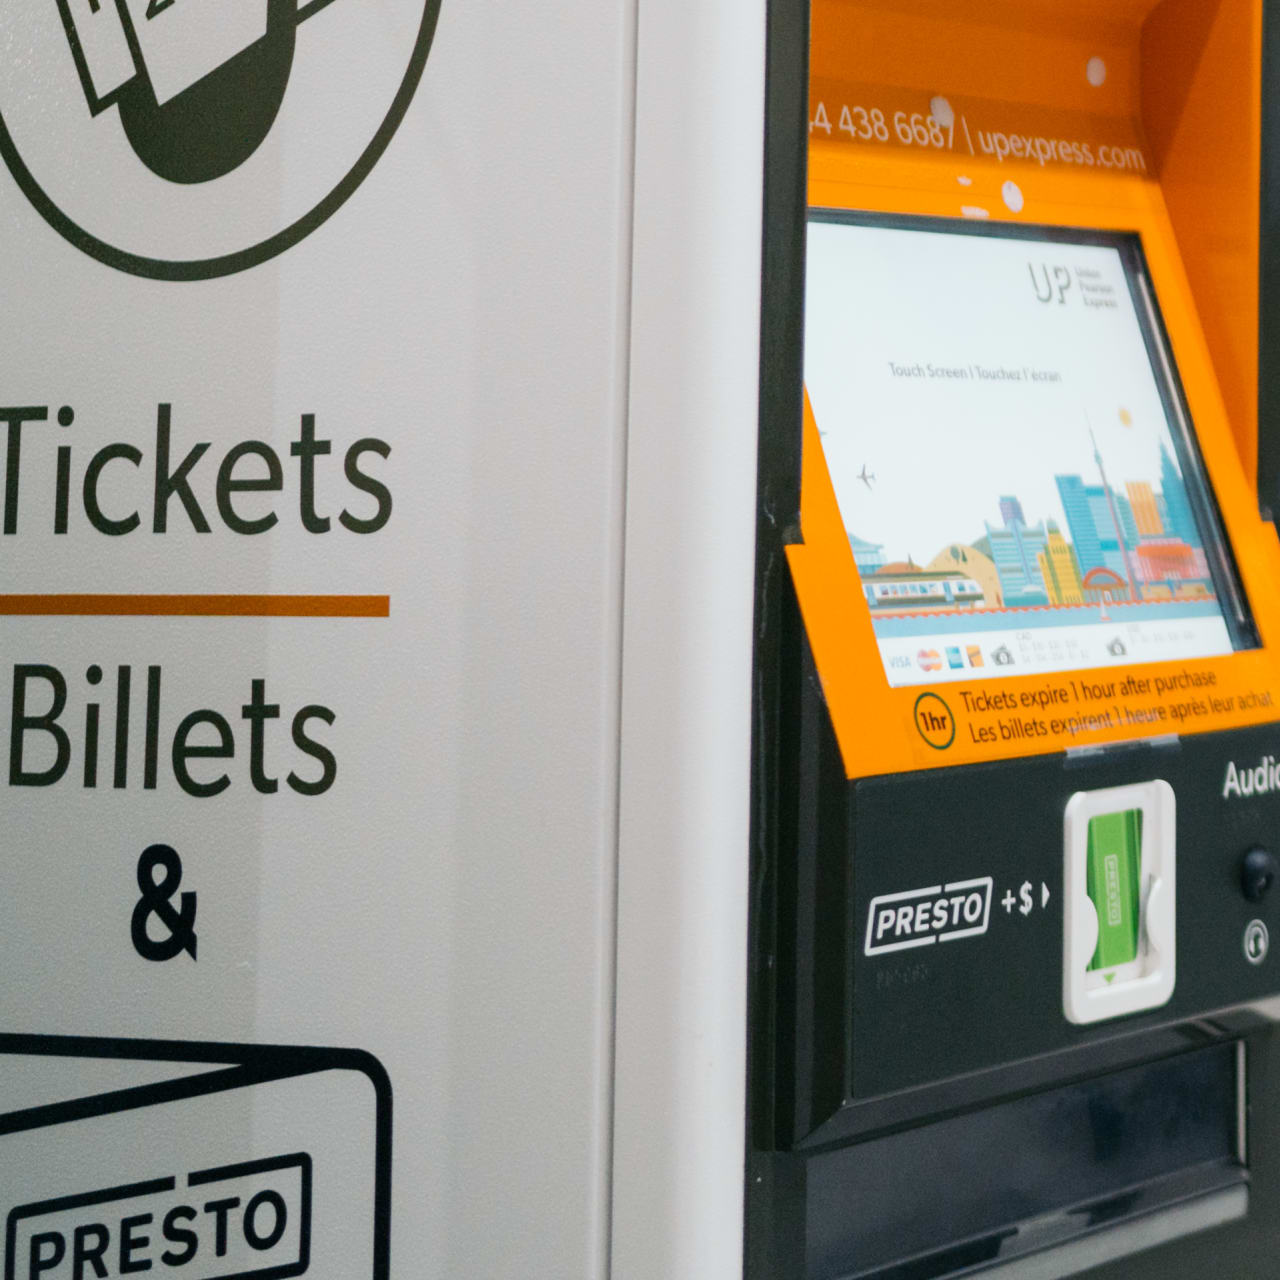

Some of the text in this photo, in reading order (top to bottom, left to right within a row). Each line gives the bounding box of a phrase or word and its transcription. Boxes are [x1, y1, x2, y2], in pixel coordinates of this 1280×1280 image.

[839, 105, 889, 141] 438
[978, 130, 1146, 170] upexpress.com
[889, 361, 925, 378] Touch
[926, 364, 968, 380] Screen
[975, 365, 1021, 381] Touchez
[0, 403, 392, 536] Tickets
[959, 668, 1217, 713] Tickets expire 1 hour after purchase
[969, 691, 1274, 744] Les billets expirent 1 heure après leur achat
[9, 664, 338, 798] Billets
[920, 711, 947, 732] 1hr
[130, 844, 198, 962] &
[876, 892, 982, 940] PRESTO
[29, 1189, 287, 1280] PRESTO
